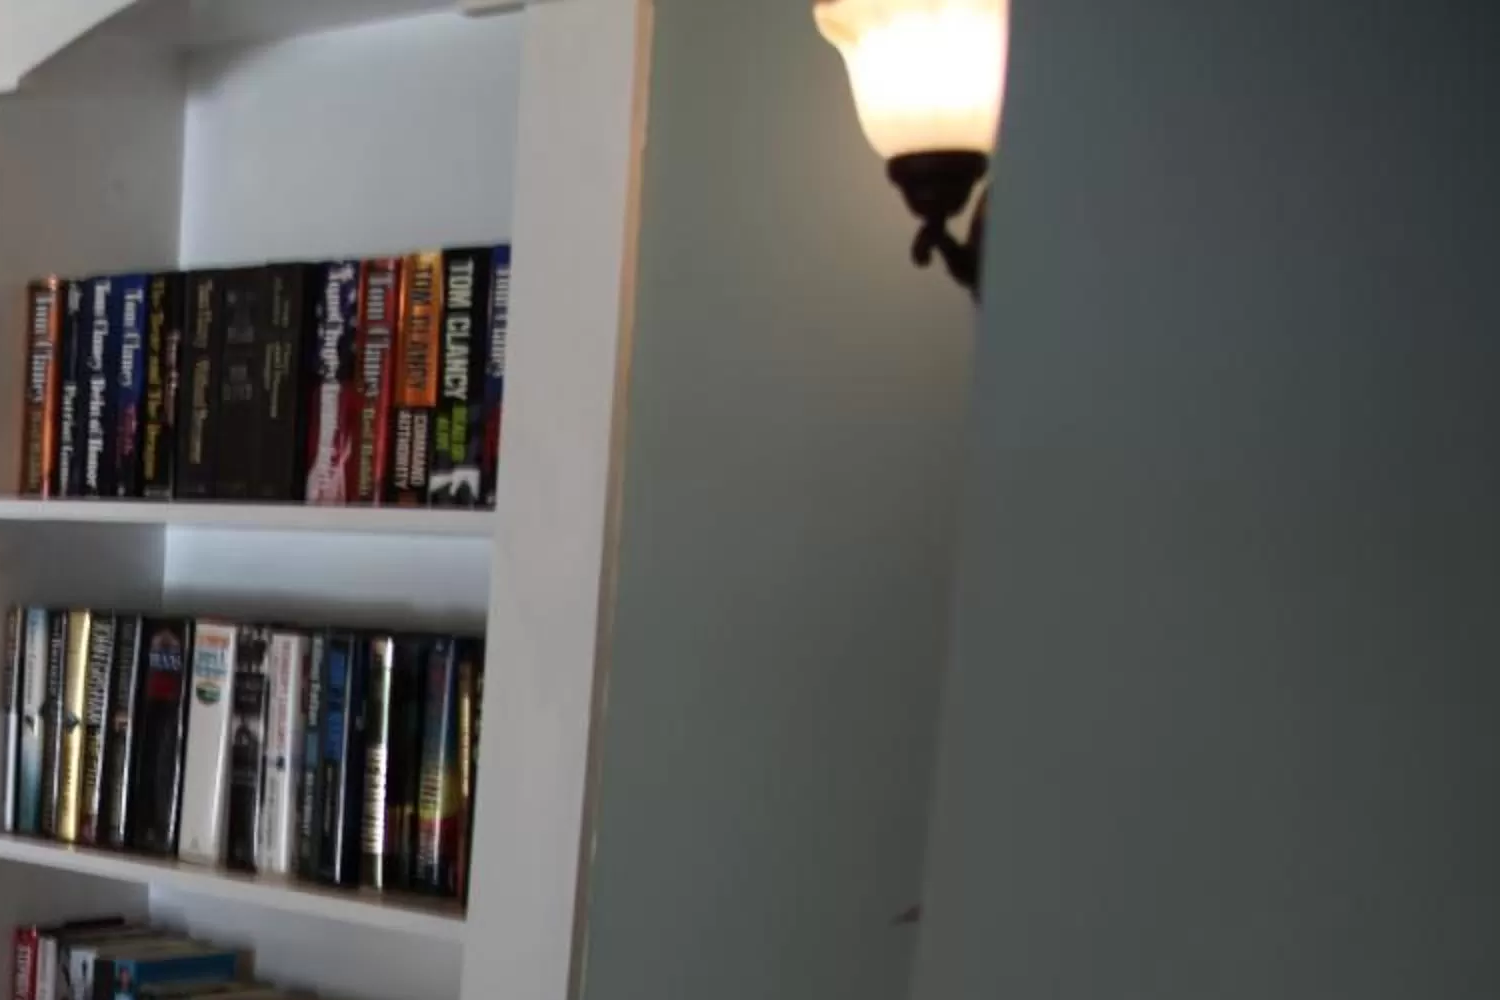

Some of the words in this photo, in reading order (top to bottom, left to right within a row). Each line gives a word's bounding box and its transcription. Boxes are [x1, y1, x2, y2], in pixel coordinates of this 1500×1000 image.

[448, 258, 474, 308] TOM
[123, 289, 143, 328] Tom
[444, 317, 470, 401] CLANCY
